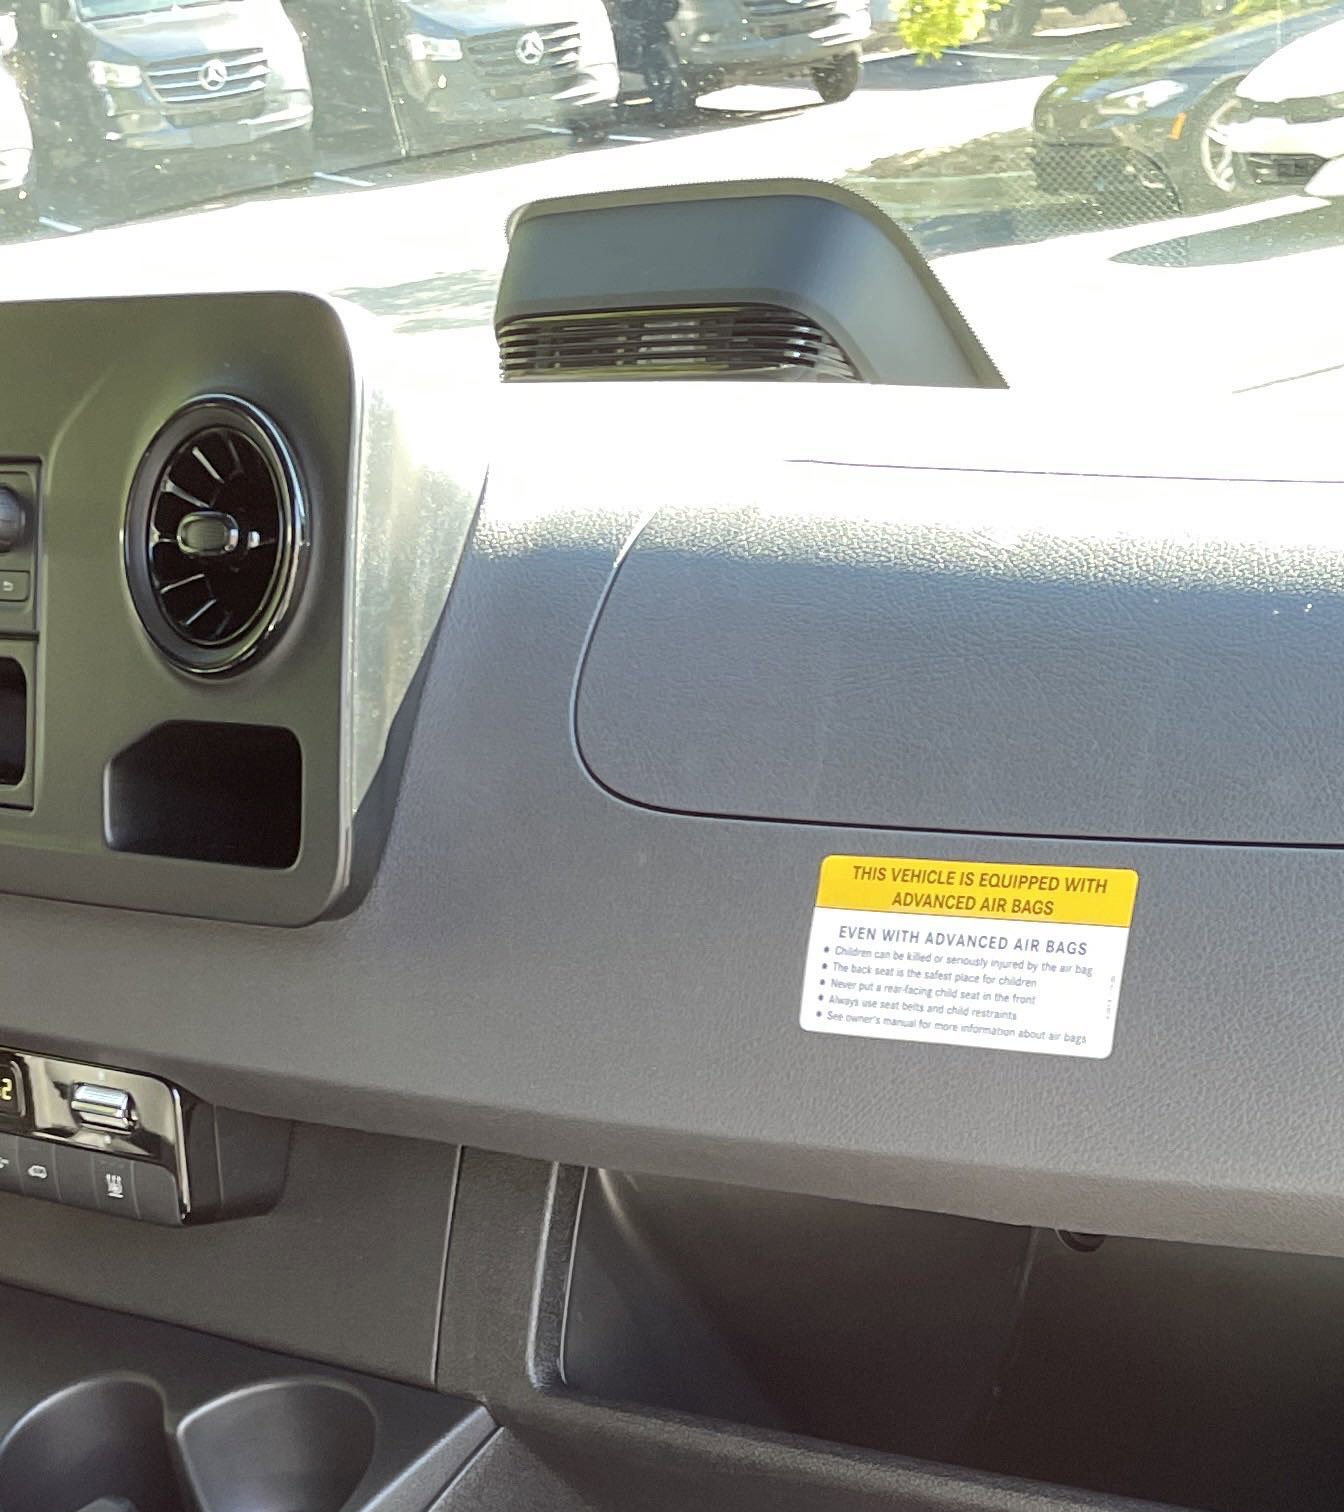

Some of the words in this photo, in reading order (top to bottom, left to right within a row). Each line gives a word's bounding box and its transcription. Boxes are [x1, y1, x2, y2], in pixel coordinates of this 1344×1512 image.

[853, 866, 886, 882] THIS
[892, 868, 956, 885] VEHICLE
[959, 871, 975, 886] IS
[979, 873, 1060, 891] EQUIPPED
[1065, 877, 1108, 893] WITH
[891, 892, 976, 910] ADVANCED
[980, 897, 1007, 912] AIR
[1011, 899, 1054, 915] BAGS
[839, 925, 876, 940] EVEN
[882, 929, 920, 943] WITH
[925, 932, 1008, 949] ADVANCED
[1014, 938, 1040, 952] AIR
[1046, 940, 1087, 955] BAGS
[835, 945, 872, 958] Children
[874, 950, 890, 959] can
[892, 950, 904, 960] be
[907, 951, 932, 963] killed
[934, 954, 943, 963] or
[946, 956, 987, 969] seriously
[991, 959, 1024, 971] injured
[1027, 961, 1038, 972] by
[1041, 962, 1057, 972] the
[1059, 964, 1072, 973] air
[1075, 964, 1093, 977] bag
[833, 962, 849, 973] The
[851, 963, 872, 974] back
[875, 967, 894, 977] seat
[896, 968, 904, 977] is
[907, 968, 922, 978] the
[924, 969, 953, 981] safest
[955, 972, 979, 984] place
[982, 973, 995, 984] for
[998, 975, 1037, 987] children
[831, 978, 857, 990] Never
[859, 982, 874, 992] put
[884, 984, 933, 998] rear-facing
[935, 987, 957, 998] child
[960, 990, 980, 1000] seat
[983, 992, 991, 1001] in
[994, 992, 1009, 1002] the
[1012, 994, 1036, 1004] front
[829, 995, 859, 1008] Always
[862, 999, 878, 1008] use
[880, 1000, 899, 1009] seat
[902, 1001, 924, 1012] belts
[927, 1003, 944, 1013] and
[946, 1005, 969, 1016] child
[971, 1009, 1017, 1020] restraints
[827, 1011, 843, 1021] See
[846, 1014, 881, 1025] owner's
[883, 1017, 916, 1028] manual
[918, 1019, 932, 1029] for
[934, 1021, 958, 1032] more
[960, 1023, 1015, 1037] information
[1018, 1029, 1046, 1040] about
[1048, 1031, 1061, 1041] air
[1063, 1033, 1086, 1045] bags
